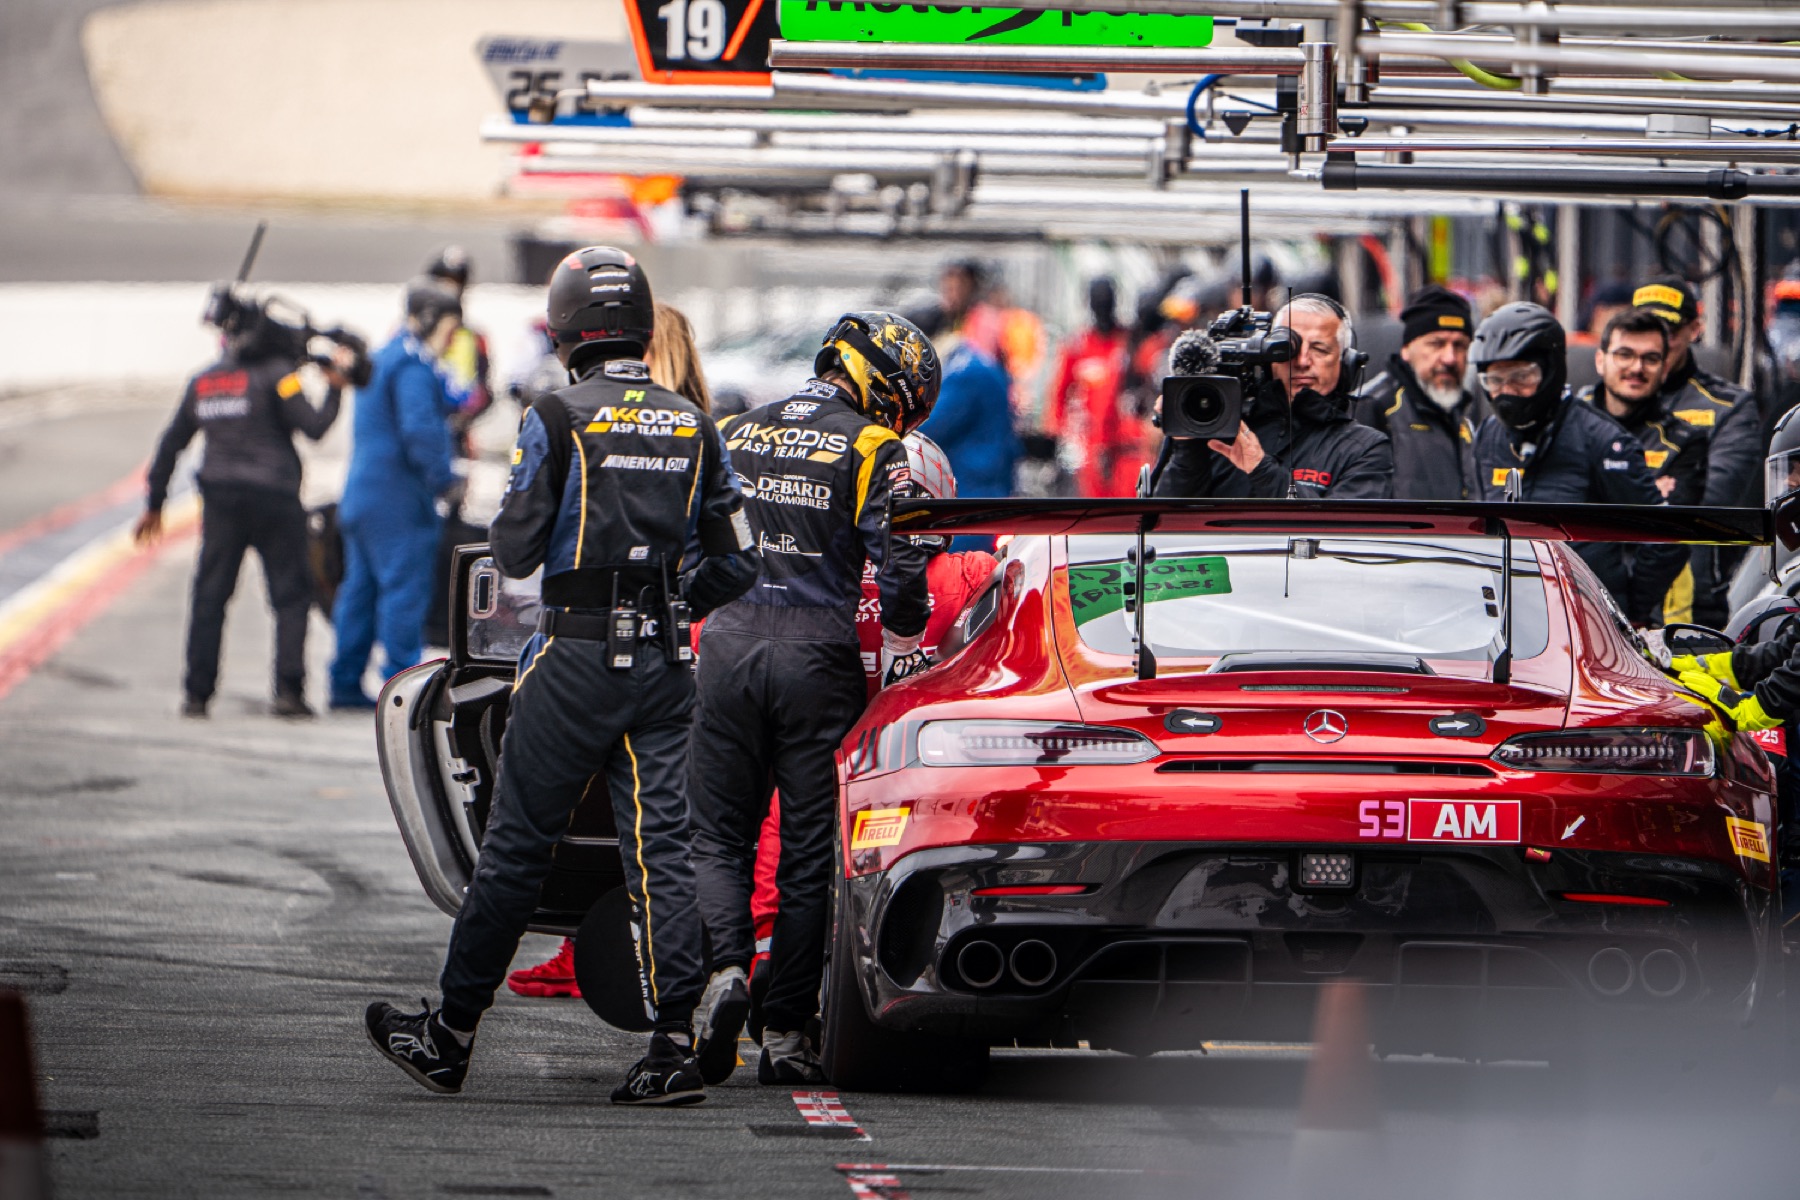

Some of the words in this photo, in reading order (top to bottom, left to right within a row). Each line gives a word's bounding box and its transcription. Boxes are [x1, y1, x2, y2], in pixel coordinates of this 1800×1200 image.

[658, 0, 726, 61] 19
[611, 423, 635, 433] ASP
[637, 424, 672, 436] TEAM
[741, 440, 771, 455] ASP
[773, 445, 808, 459] TEAM
[600, 455, 664, 470] MINERVA
[668, 458, 687, 471] OIL
[757, 476, 832, 500] DEBARD
[857, 816, 902, 841] PIRELLI
[1432, 804, 1497, 839] AM
[1731, 825, 1766, 854] PIRELLI
